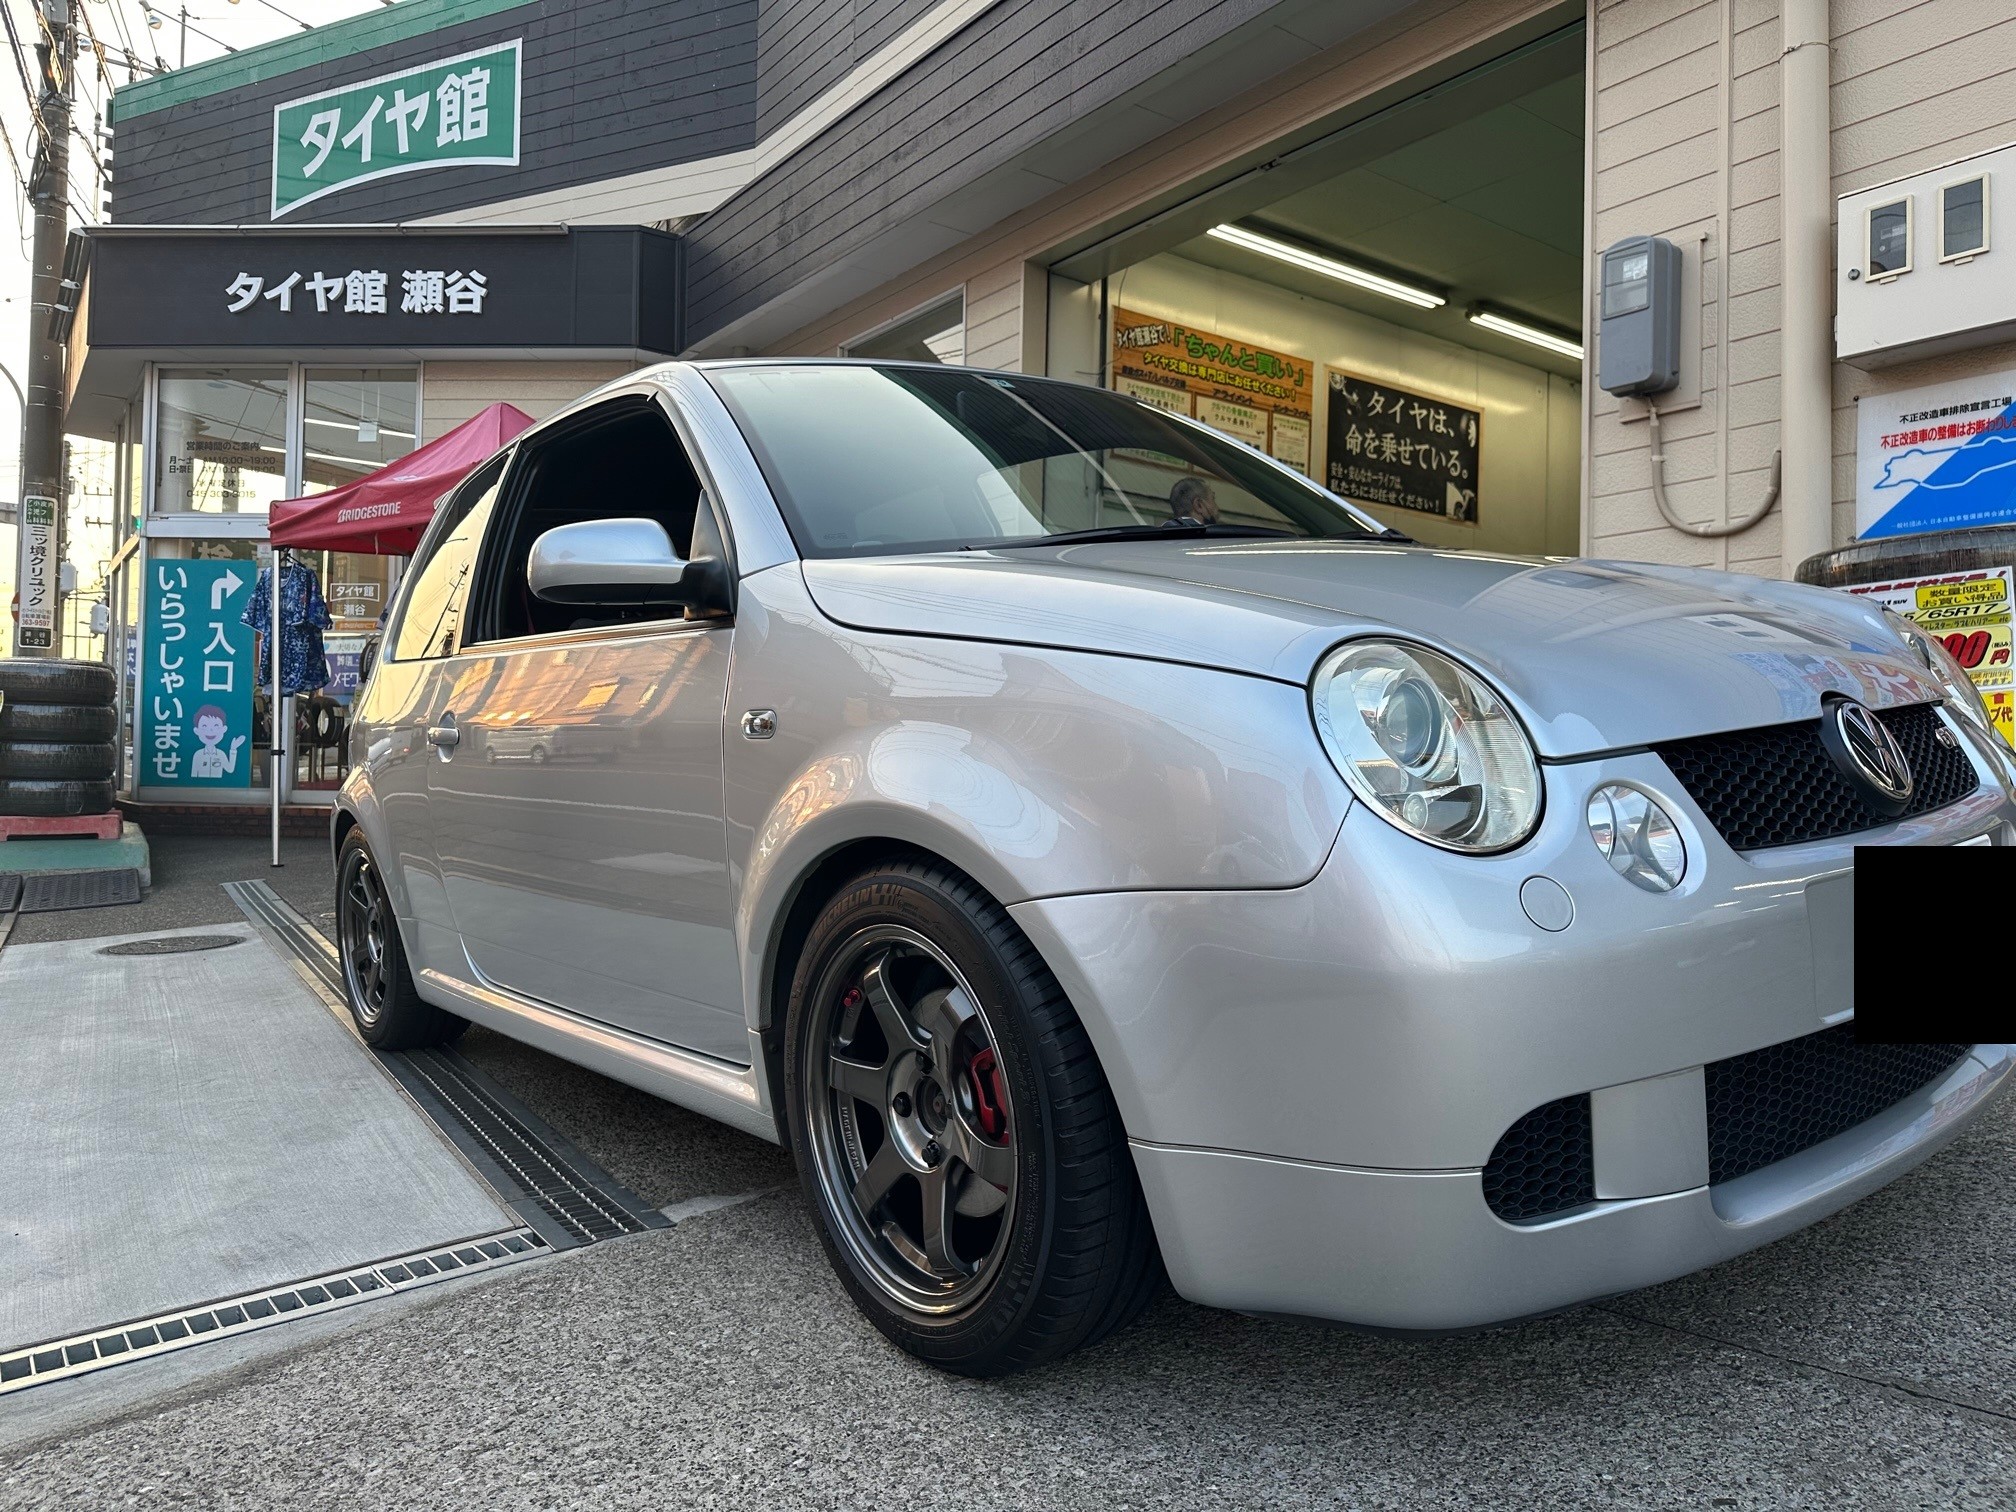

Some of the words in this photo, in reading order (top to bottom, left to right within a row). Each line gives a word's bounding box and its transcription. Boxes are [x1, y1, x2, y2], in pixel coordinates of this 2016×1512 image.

[299, 66, 489, 178] タイヤ館
[226, 270, 387, 314] タイヤ館
[401, 270, 487, 314] 瀬谷
[1367, 391, 1455, 437] タイヤは、
[1899, 396, 2012, 424] 不正改造車排除宣言工場
[186, 441, 259, 451] 営業時間のご案内
[1345, 424, 1468, 479] 命を乗せている。
[337, 501, 401, 523] BRIDGESTONE
[336, 586, 374, 597] タイヤ館
[1923, 592, 2004, 608] お買い得品
[1930, 584, 1997, 598] 数量限定
[343, 604, 366, 616] 瀬谷
[1904, 603, 1998, 622] 5/65R17
[203, 622, 236, 692] 入口
[1989, 648, 2010, 665] 円
[153, 566, 187, 778] いらっしゃいませ
